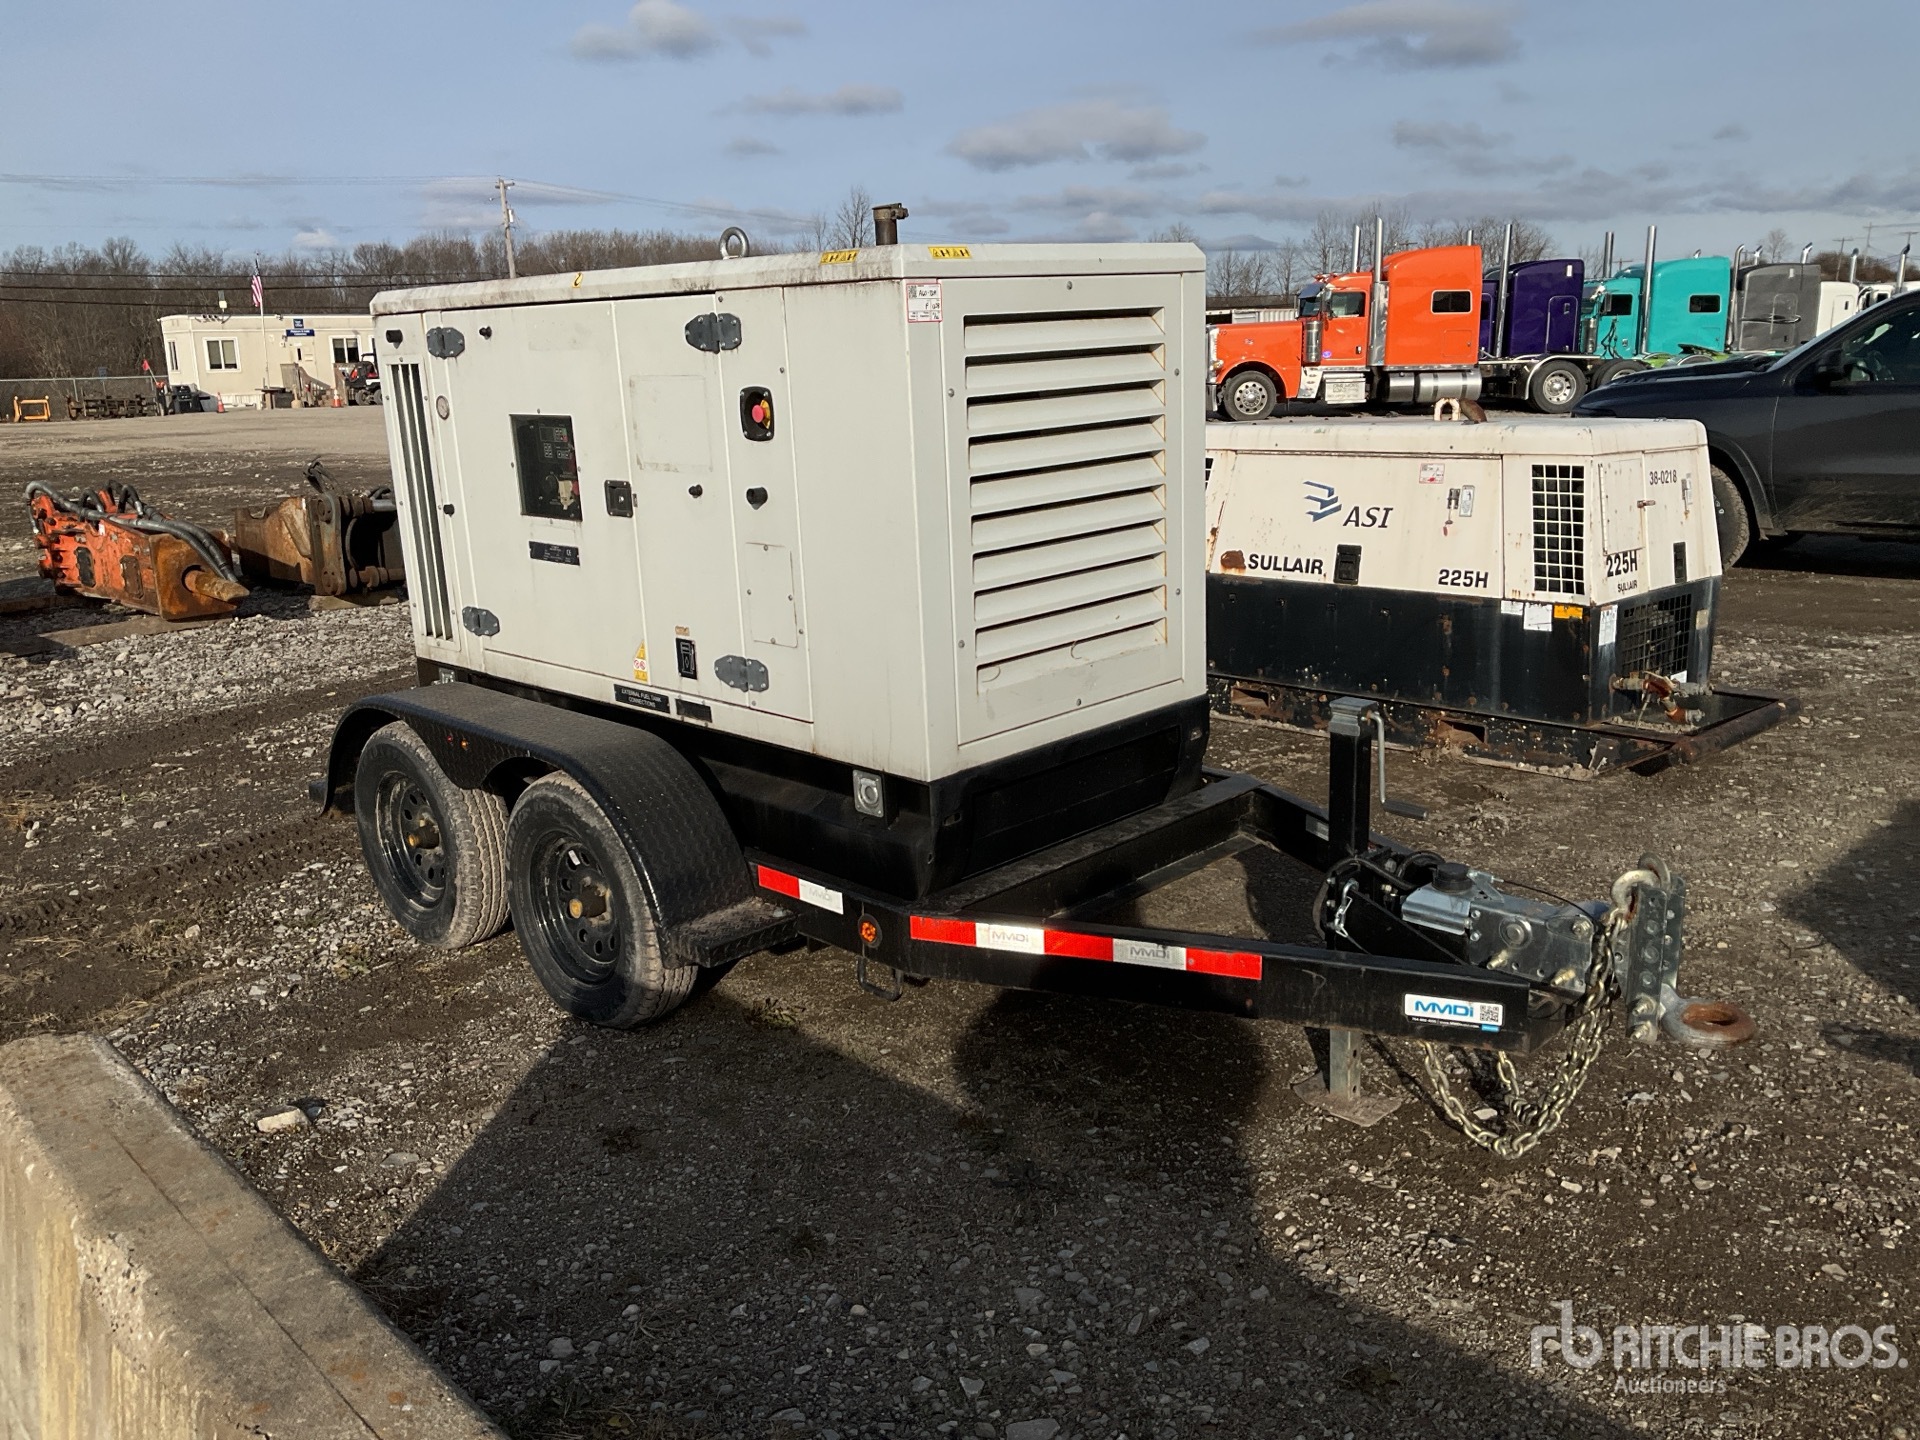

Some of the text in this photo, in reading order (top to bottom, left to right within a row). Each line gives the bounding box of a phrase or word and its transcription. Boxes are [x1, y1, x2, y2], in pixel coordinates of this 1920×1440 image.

[1649, 469, 1678, 486] 38-0218
[1342, 506, 1394, 528] ASI
[1248, 553, 1324, 575] SULLAIR
[1606, 549, 1638, 578] 225H
[1438, 568, 1489, 588] 225H
[621, 687, 662, 703] EXTERNAL FUEL TANK
[628, 696, 656, 708] CONNECTIONS
[1129, 945, 1170, 960] MMDi
[1415, 1000, 1474, 1017] MMDi
